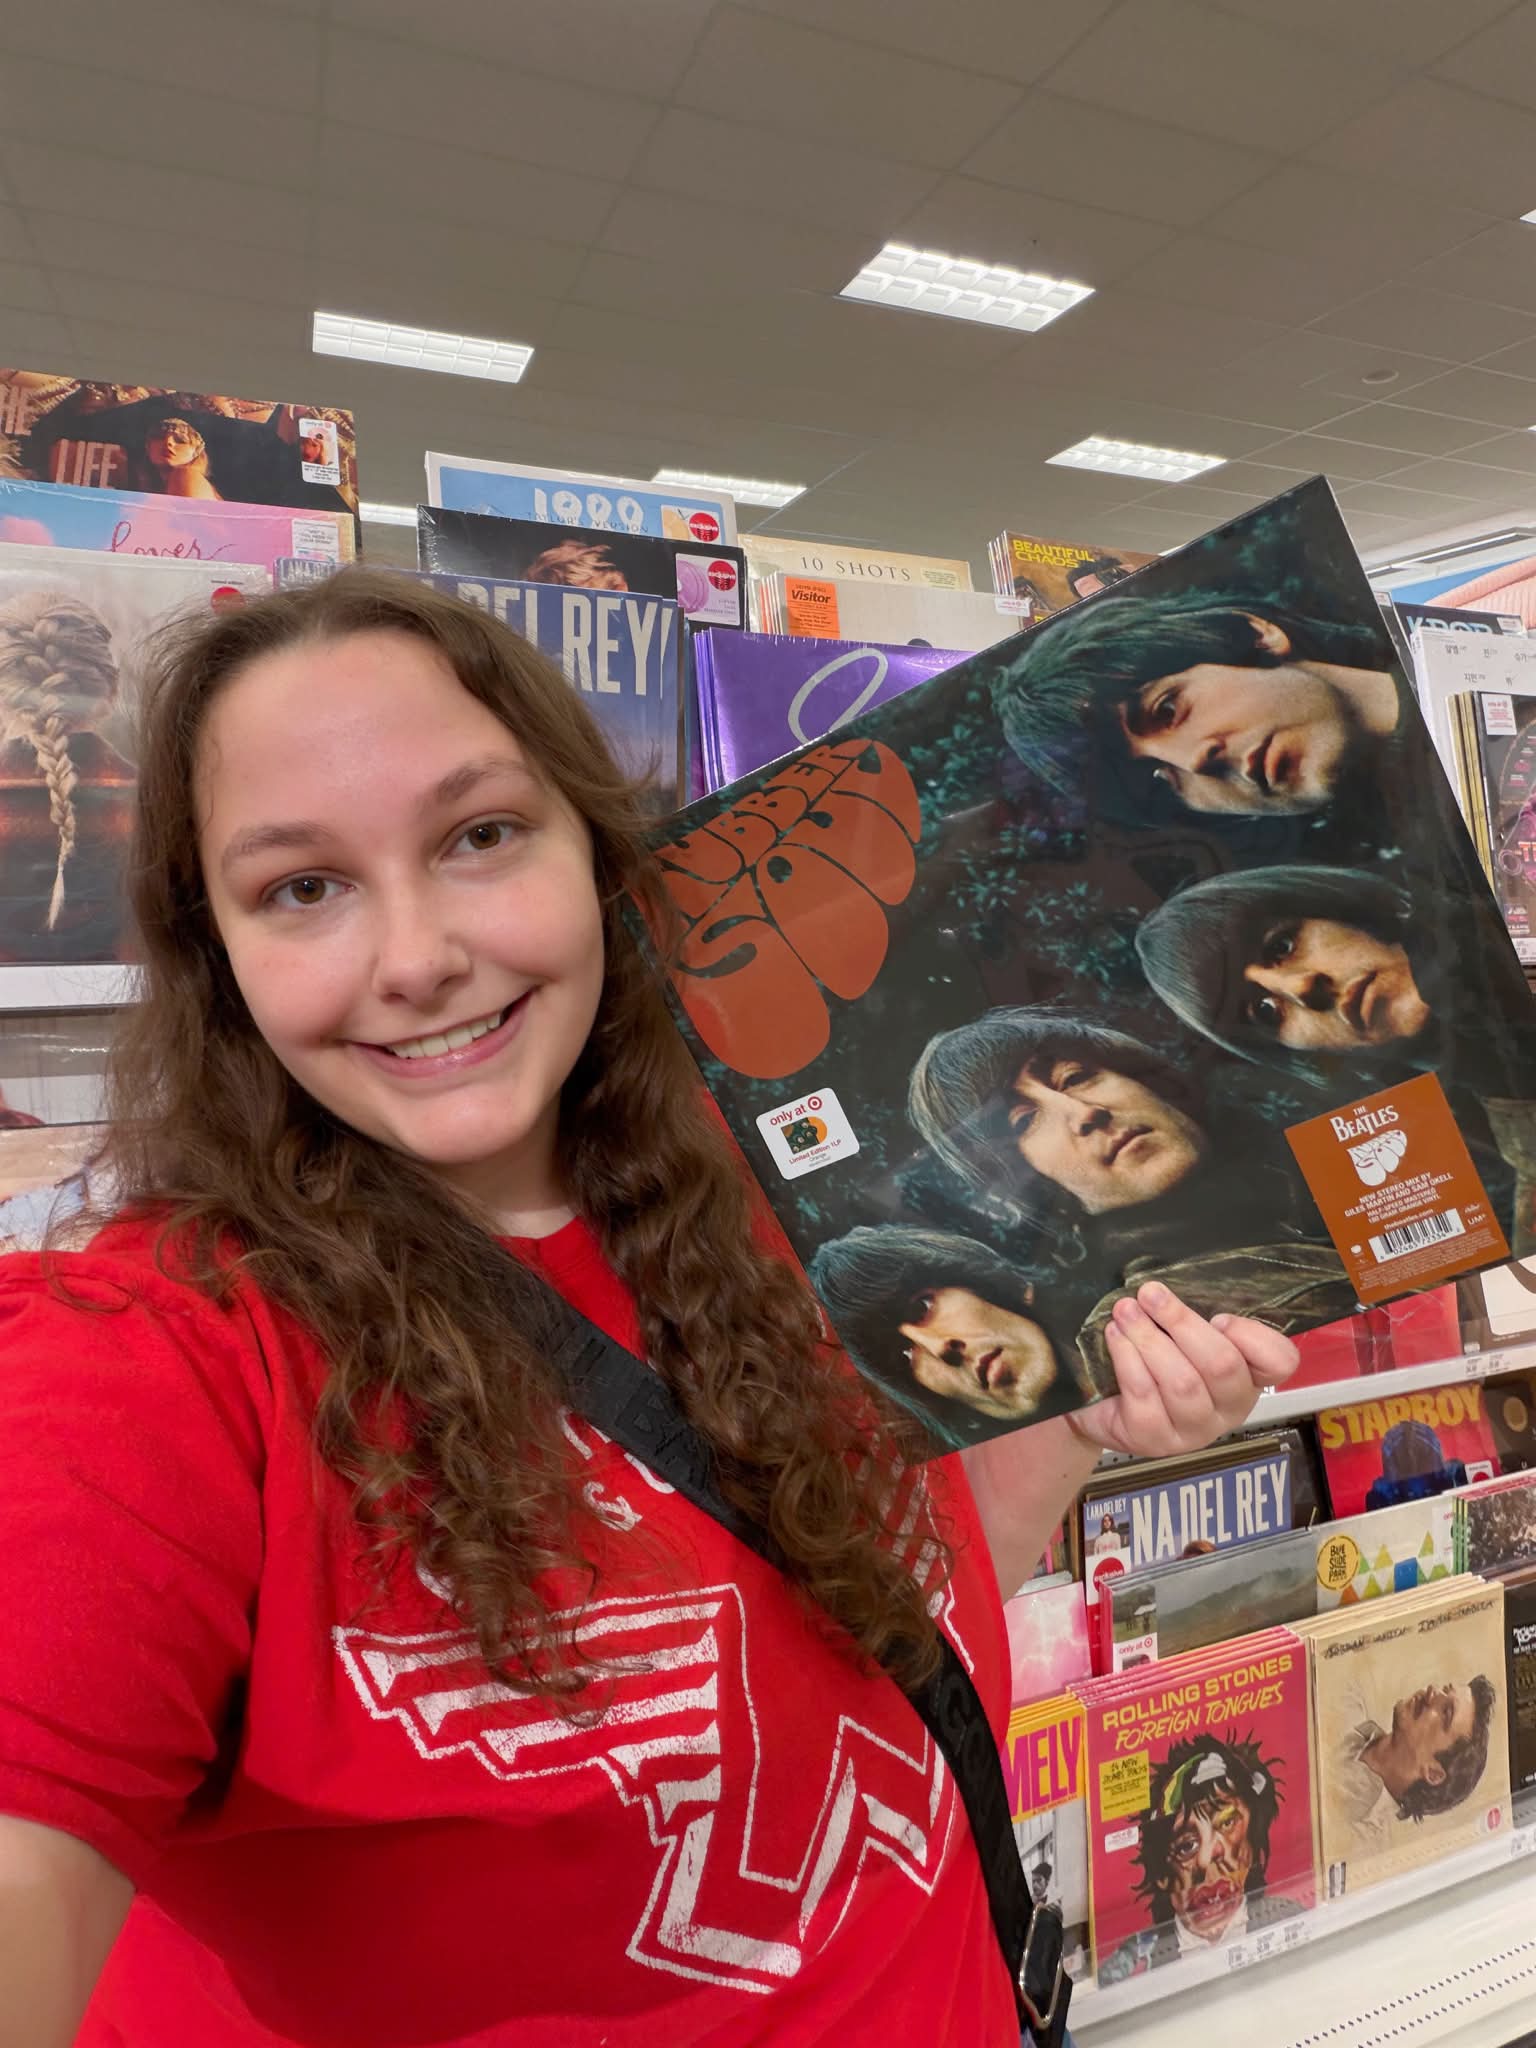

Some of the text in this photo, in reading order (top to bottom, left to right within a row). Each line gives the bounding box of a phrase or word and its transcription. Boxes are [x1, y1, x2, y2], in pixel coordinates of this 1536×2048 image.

[1013, 539, 1096, 562] BEAUTIFUL
[1015, 551, 1080, 569] CHAOS
[801, 555, 824, 571] 10
[835, 560, 912, 583] SHOTS
[791, 589, 831, 604] Visitor
[563, 592, 658, 697] REY
[670, 738, 922, 1080] SOUL
[769, 1104, 808, 1126] only at
[1329, 1105, 1399, 1142] BEATLES
[1353, 1105, 1367, 1116] THE
[1344, 1172, 1454, 1218] GILES MARTIN AND SAM OKELL
[1359, 1172, 1432, 1204] NEW STEREO MIX BY
[1318, 1385, 1481, 1450] STARBOY
[1086, 1501, 1104, 1521] LANA
[1115, 1497, 1127, 1513] REY
[1180, 1476, 1232, 1552] DEL
[1235, 1460, 1287, 1539] REY
[1119, 1641, 1143, 1655] only at
[1102, 1653, 1293, 1731] ROLLING STONES
[1205, 1680, 1284, 1725] TONGUES
